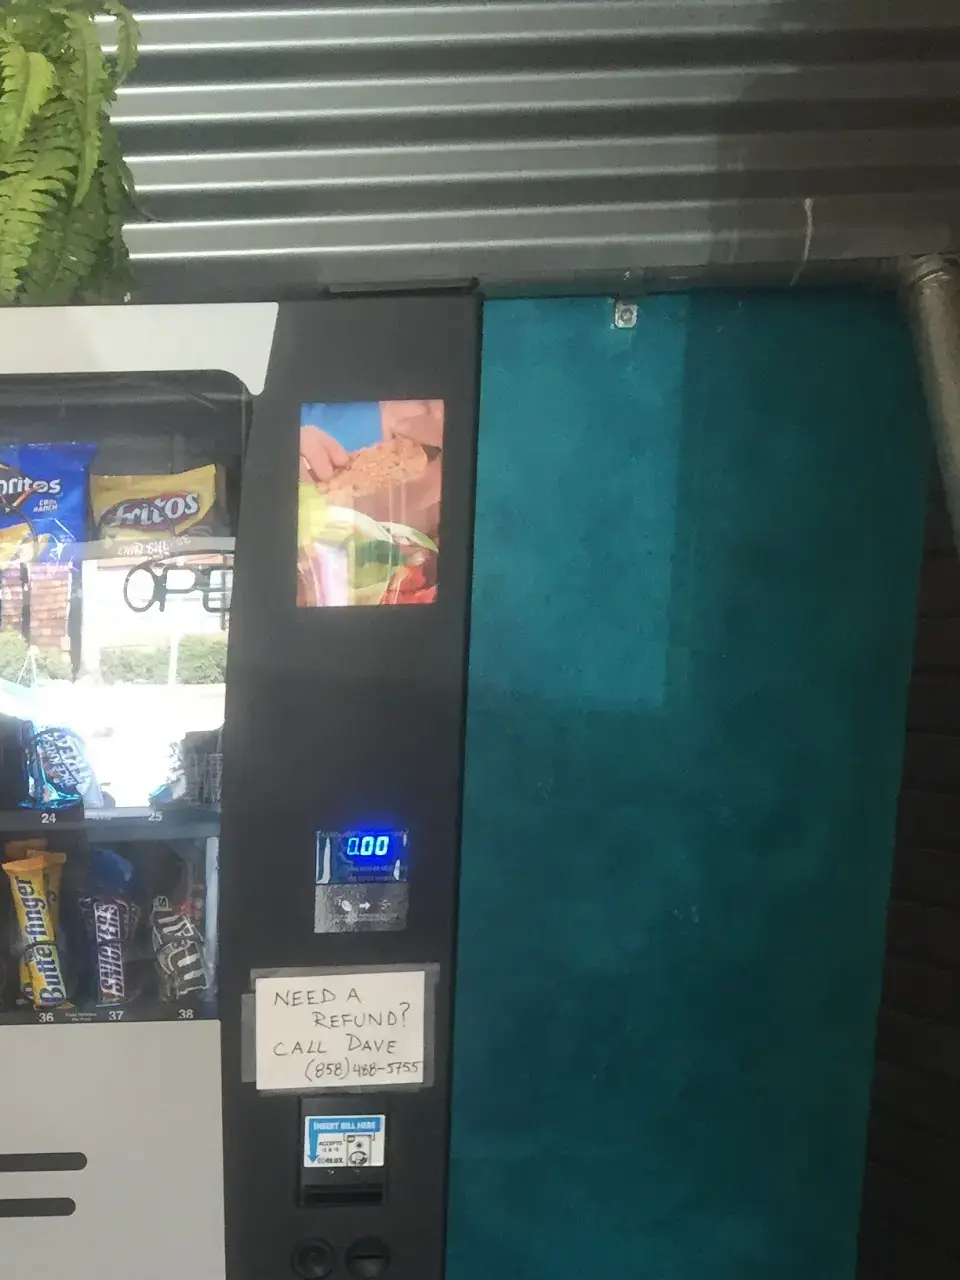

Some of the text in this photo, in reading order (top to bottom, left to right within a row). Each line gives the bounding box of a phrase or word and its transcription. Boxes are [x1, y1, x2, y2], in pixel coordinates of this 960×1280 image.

[115, 493, 198, 526] Fritos
[123, 561, 232, 613] OPE
[41, 813, 56, 824] 24
[148, 811, 163, 822] 25
[15, 875, 64, 1007] Butterfinger
[274, 988, 361, 1007] NEED A
[38, 1013, 54, 1022] 36
[108, 1010, 124, 1020] 37
[178, 1009, 194, 1019] 38
[312, 1002, 410, 1029] REFUND?
[273, 1033, 397, 1056] CALL DAVE
